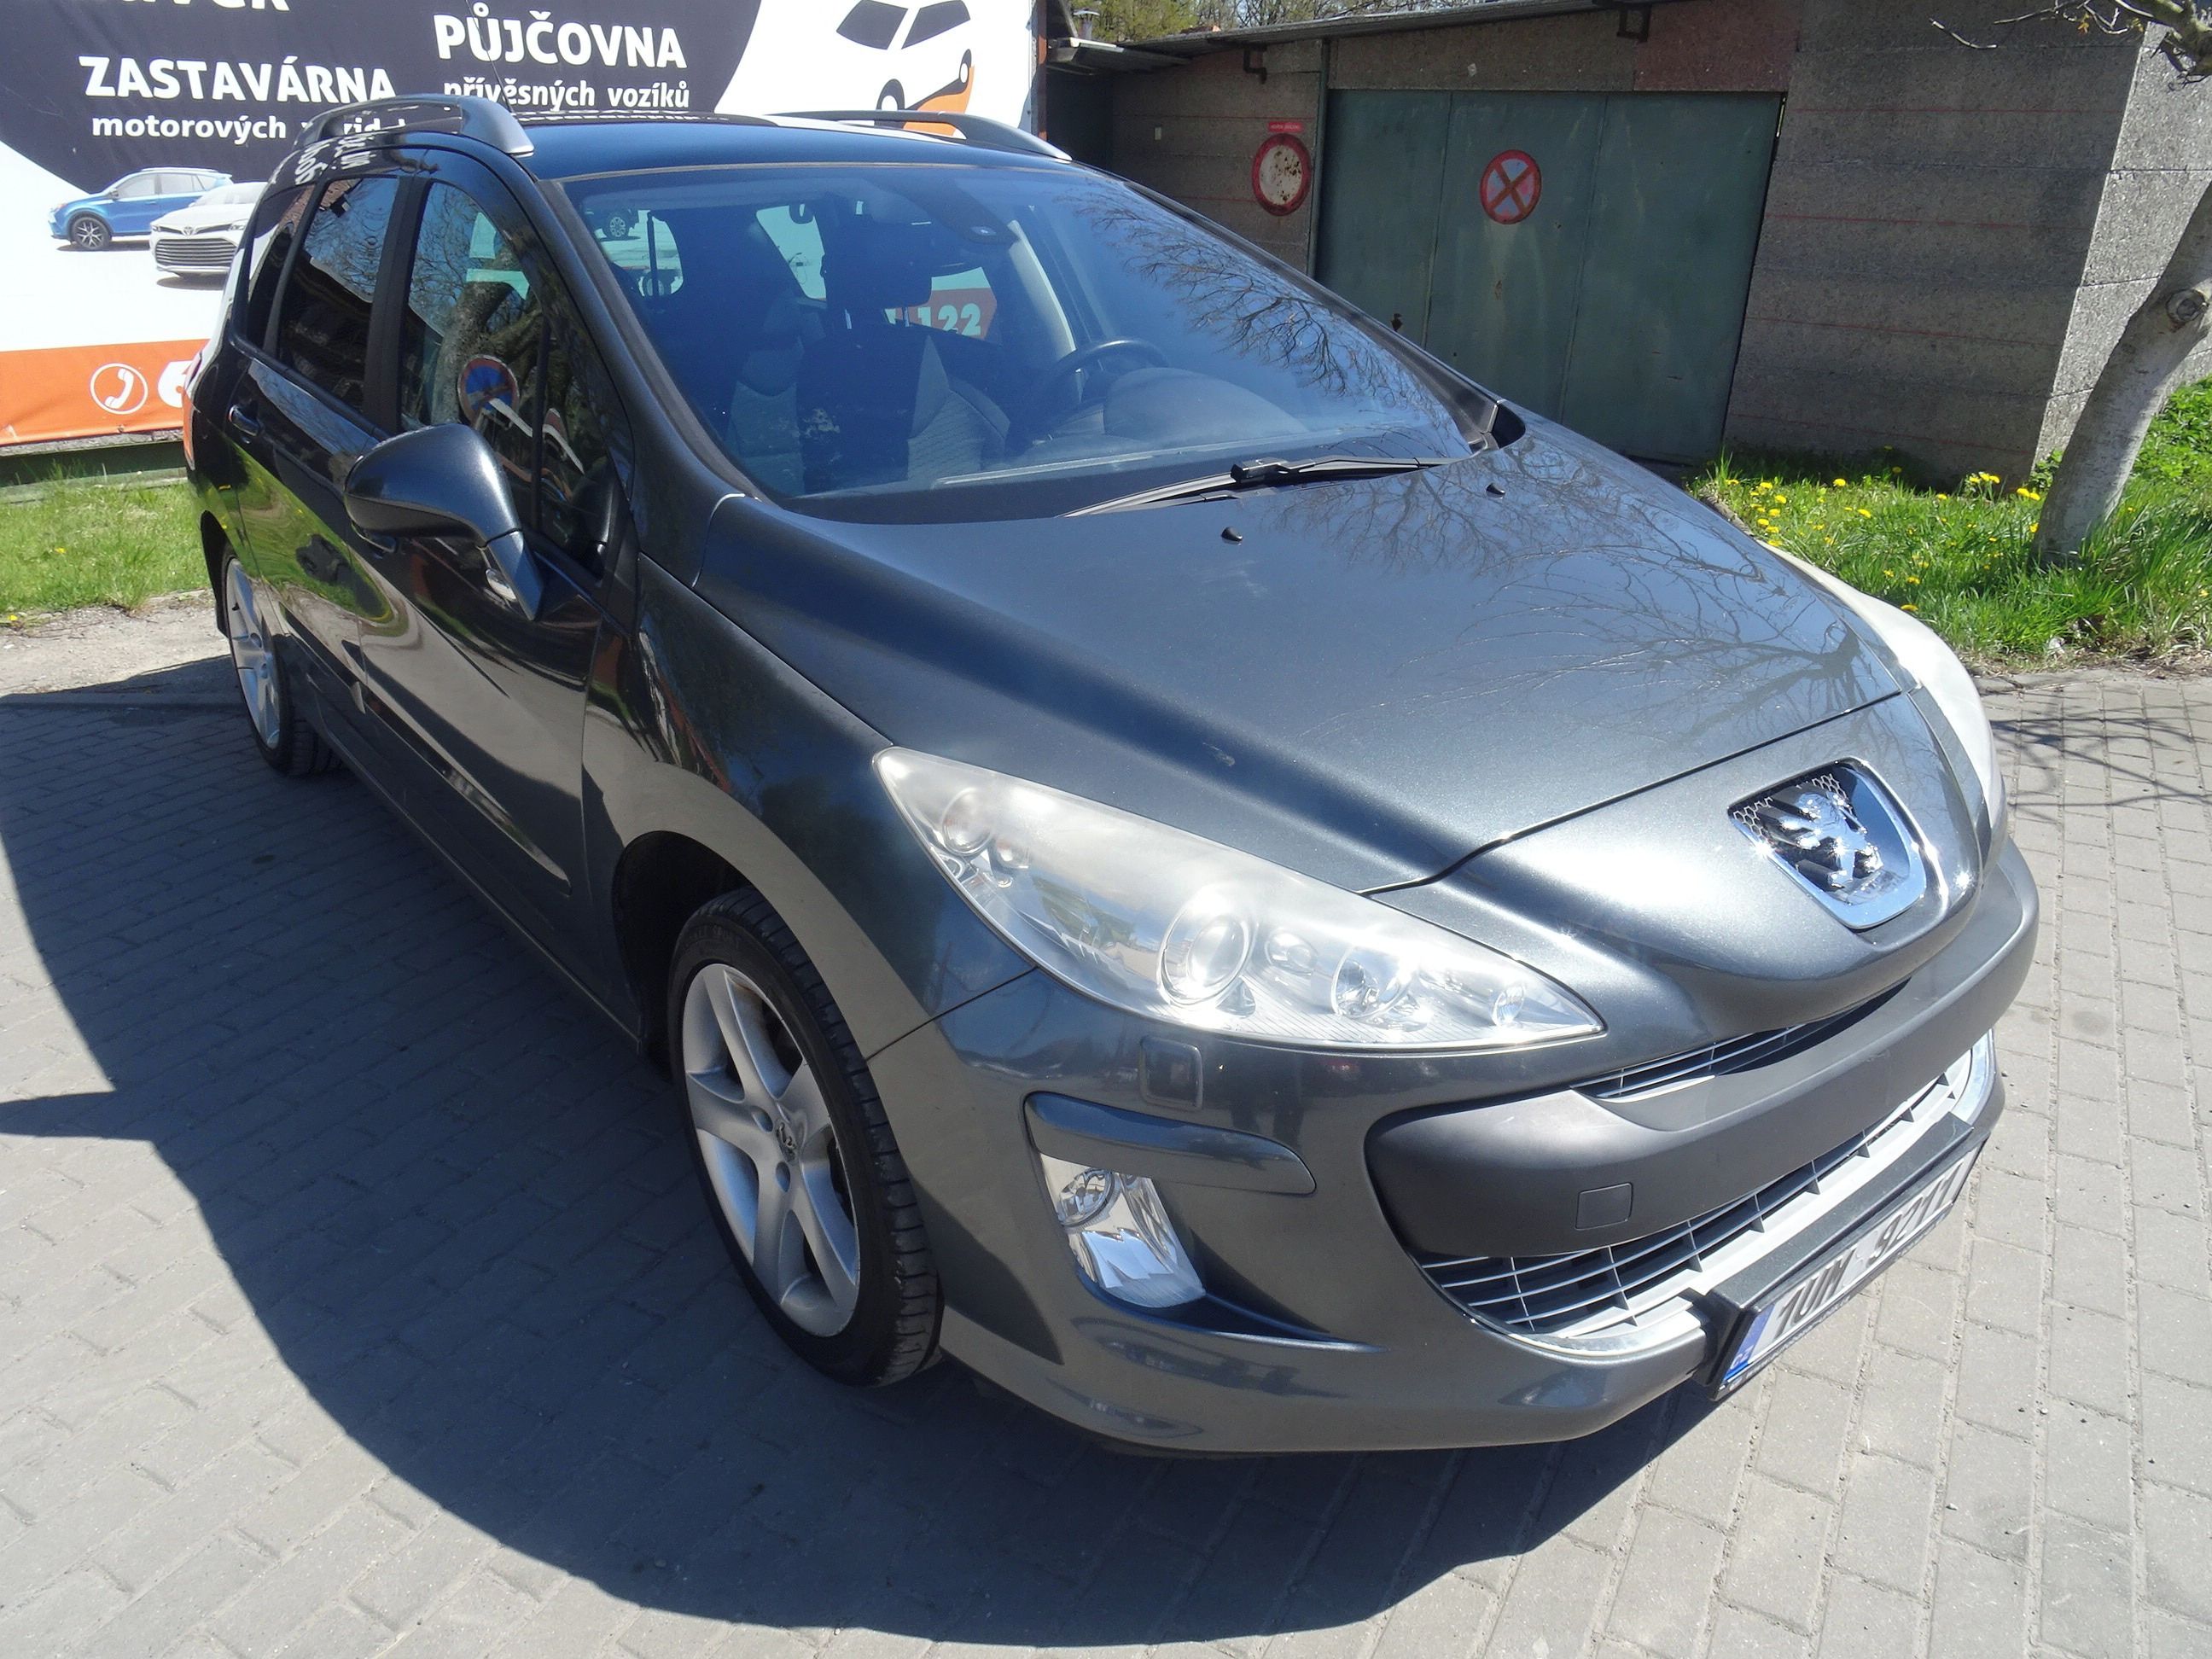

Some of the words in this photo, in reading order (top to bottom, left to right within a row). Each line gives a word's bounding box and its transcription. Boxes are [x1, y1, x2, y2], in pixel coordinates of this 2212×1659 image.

[433, 2, 688, 69] PŮJČOVNA
[78, 55, 397, 104] ZASTAVÁRNA
[607, 79, 690, 108] vozíků
[91, 114, 287, 146] motorových
